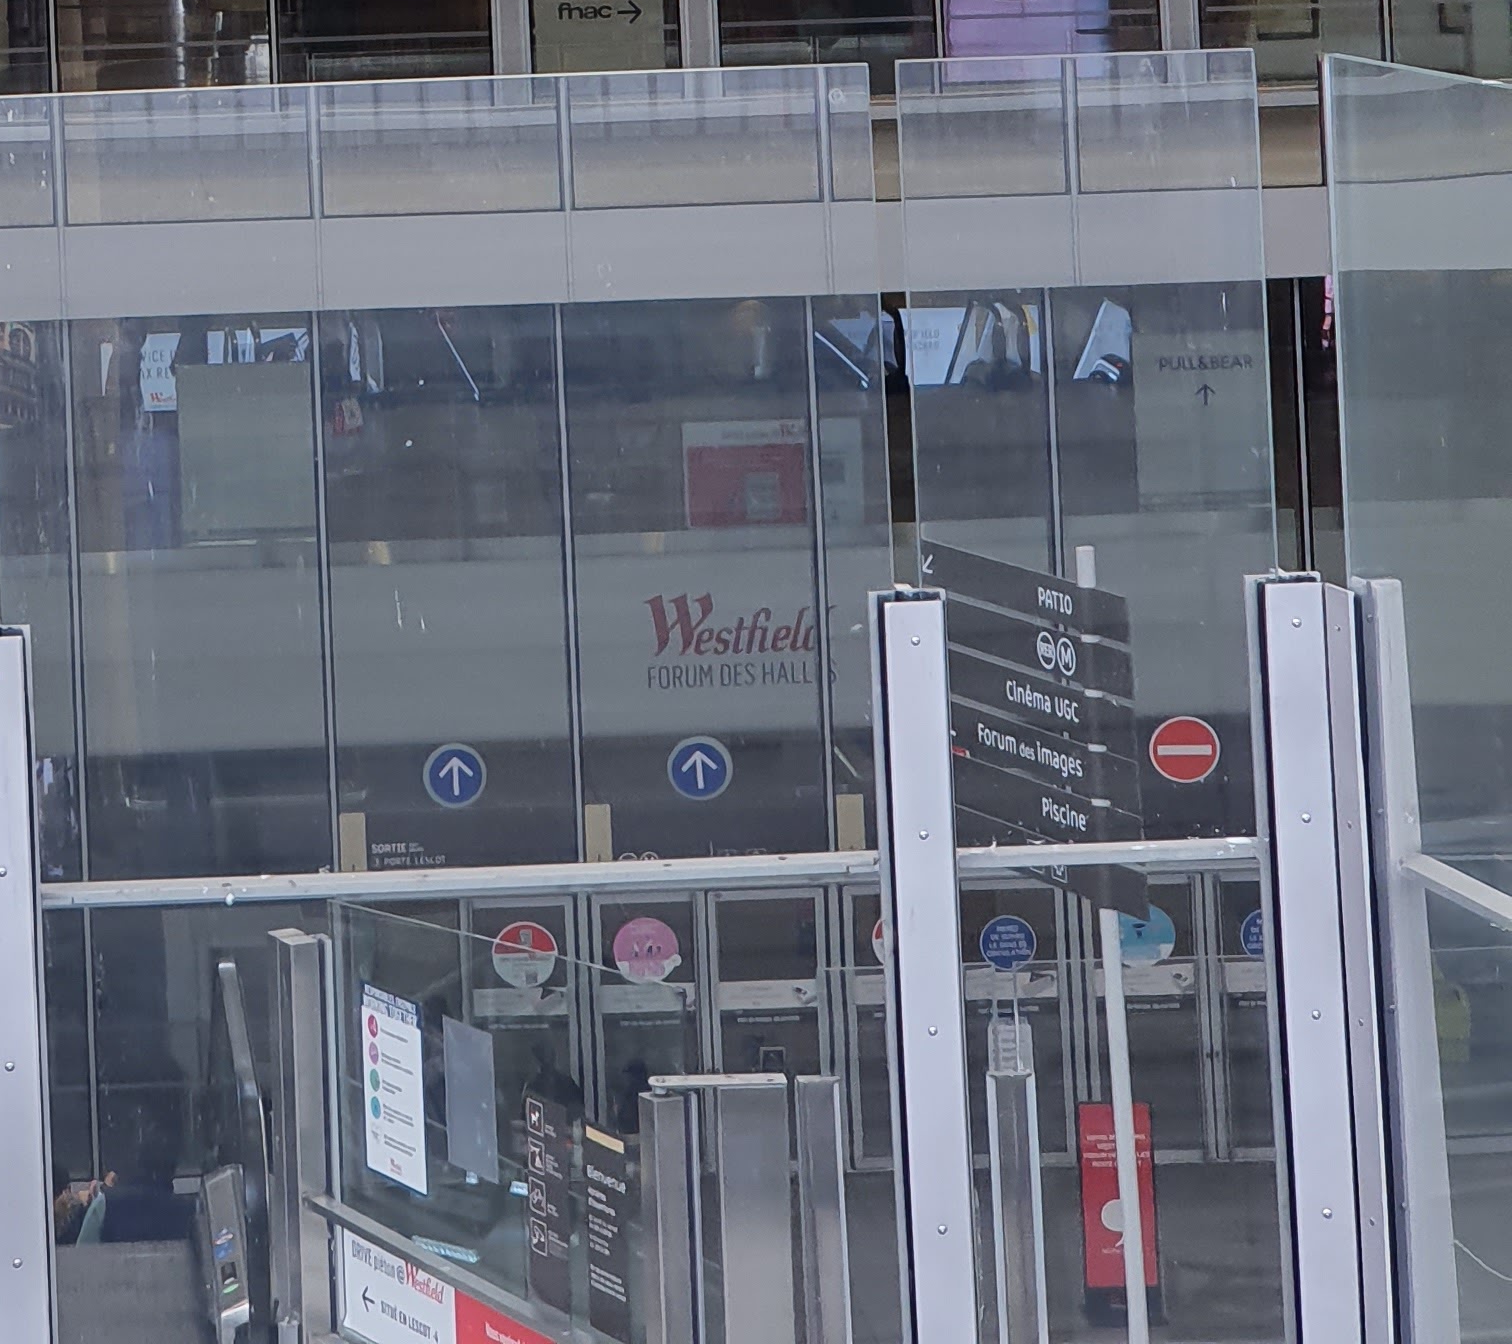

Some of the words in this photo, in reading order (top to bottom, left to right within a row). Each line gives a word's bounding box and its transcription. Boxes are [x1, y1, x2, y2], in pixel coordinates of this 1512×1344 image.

[557, 2, 612, 20] fnac
[1158, 354, 1253, 371] PULL&BEAR
[1038, 586, 1073, 615] PATIO
[648, 664, 714, 690] FORUM
[720, 662, 757, 687] DES
[762, 659, 837, 686] HALLS
[1006, 680, 1052, 713] Cinéma
[1054, 696, 1080, 723] UGC
[977, 722, 1017, 756] Forum
[1019, 741, 1036, 761] des
[1041, 796, 1087, 832] Piscine
[371, 842, 407, 854] SORTIE
[383, 856, 410, 866] PORTE
[352, 1239, 372, 1265] DRIVE
